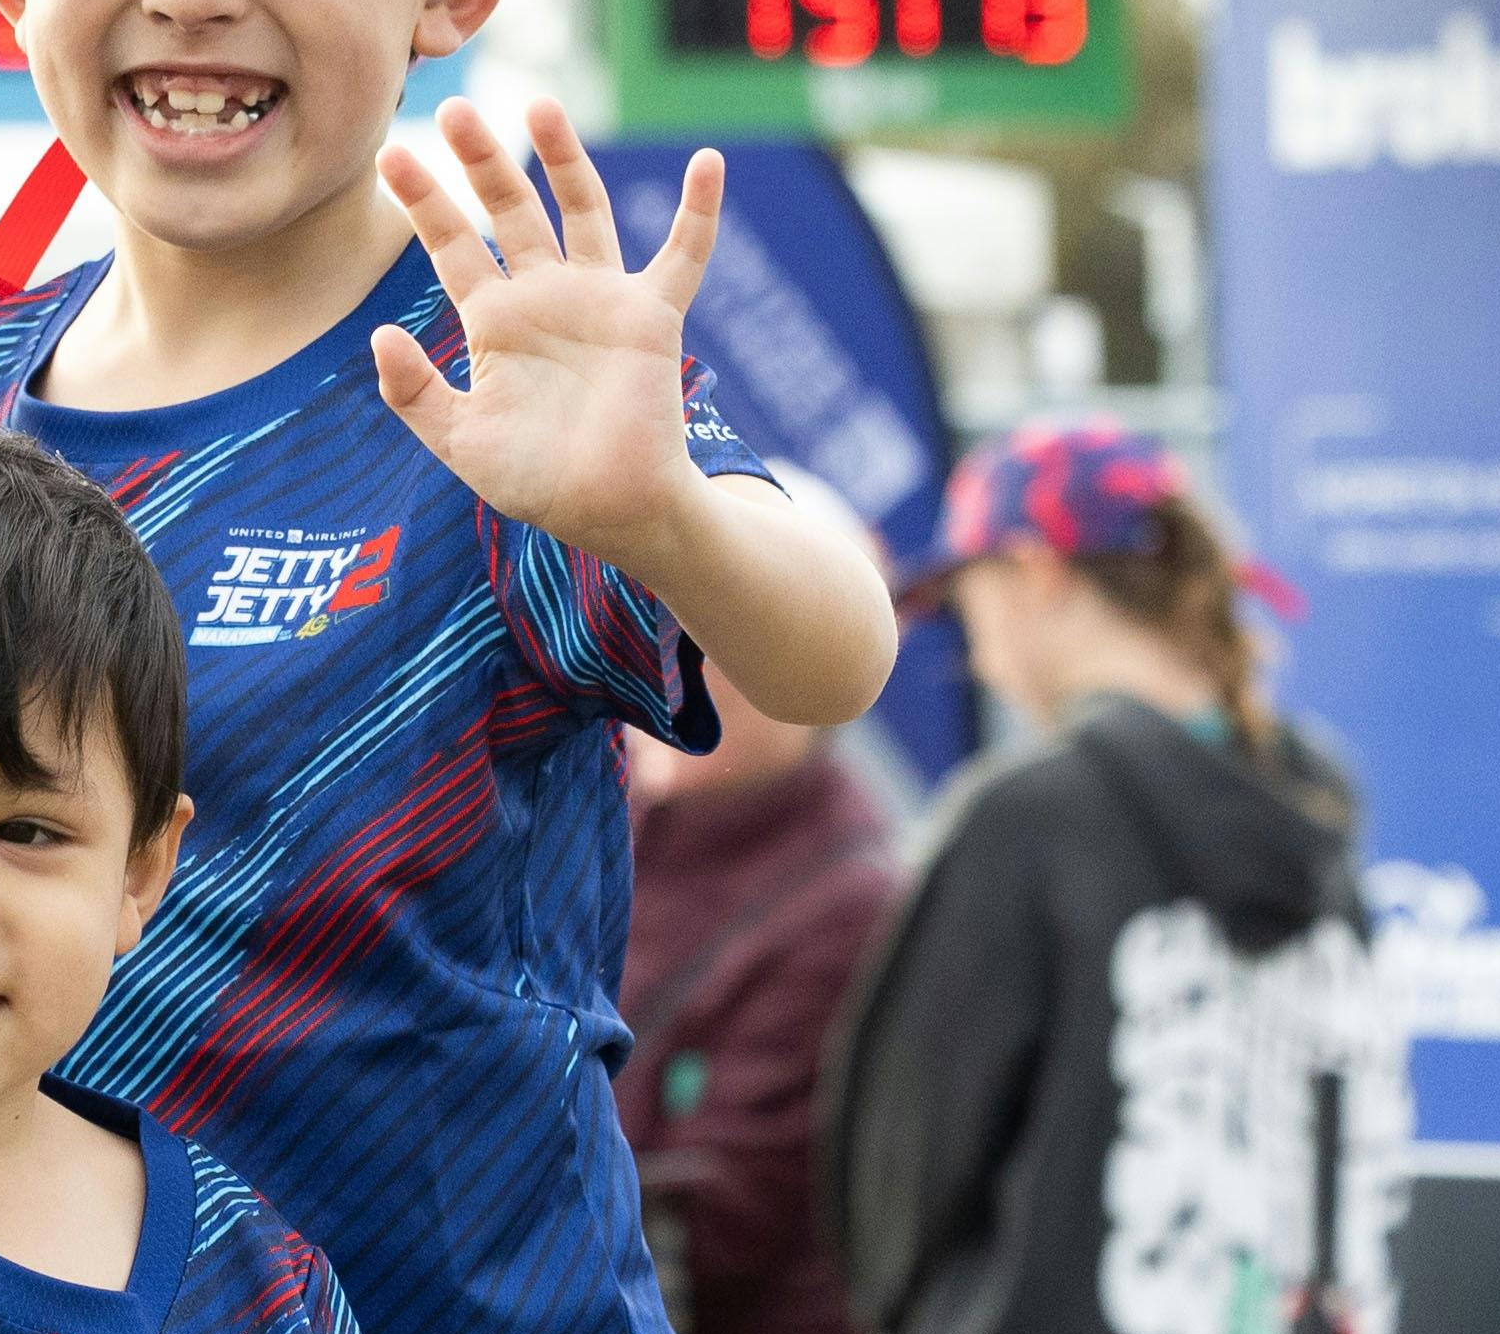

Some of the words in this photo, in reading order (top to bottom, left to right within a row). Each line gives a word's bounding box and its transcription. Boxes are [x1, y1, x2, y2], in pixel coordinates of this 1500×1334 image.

[229, 527, 284, 540] UNITED
[305, 527, 367, 542] AIRLINES
[212, 543, 362, 586] JETTY
[196, 580, 341, 626] JETTY
